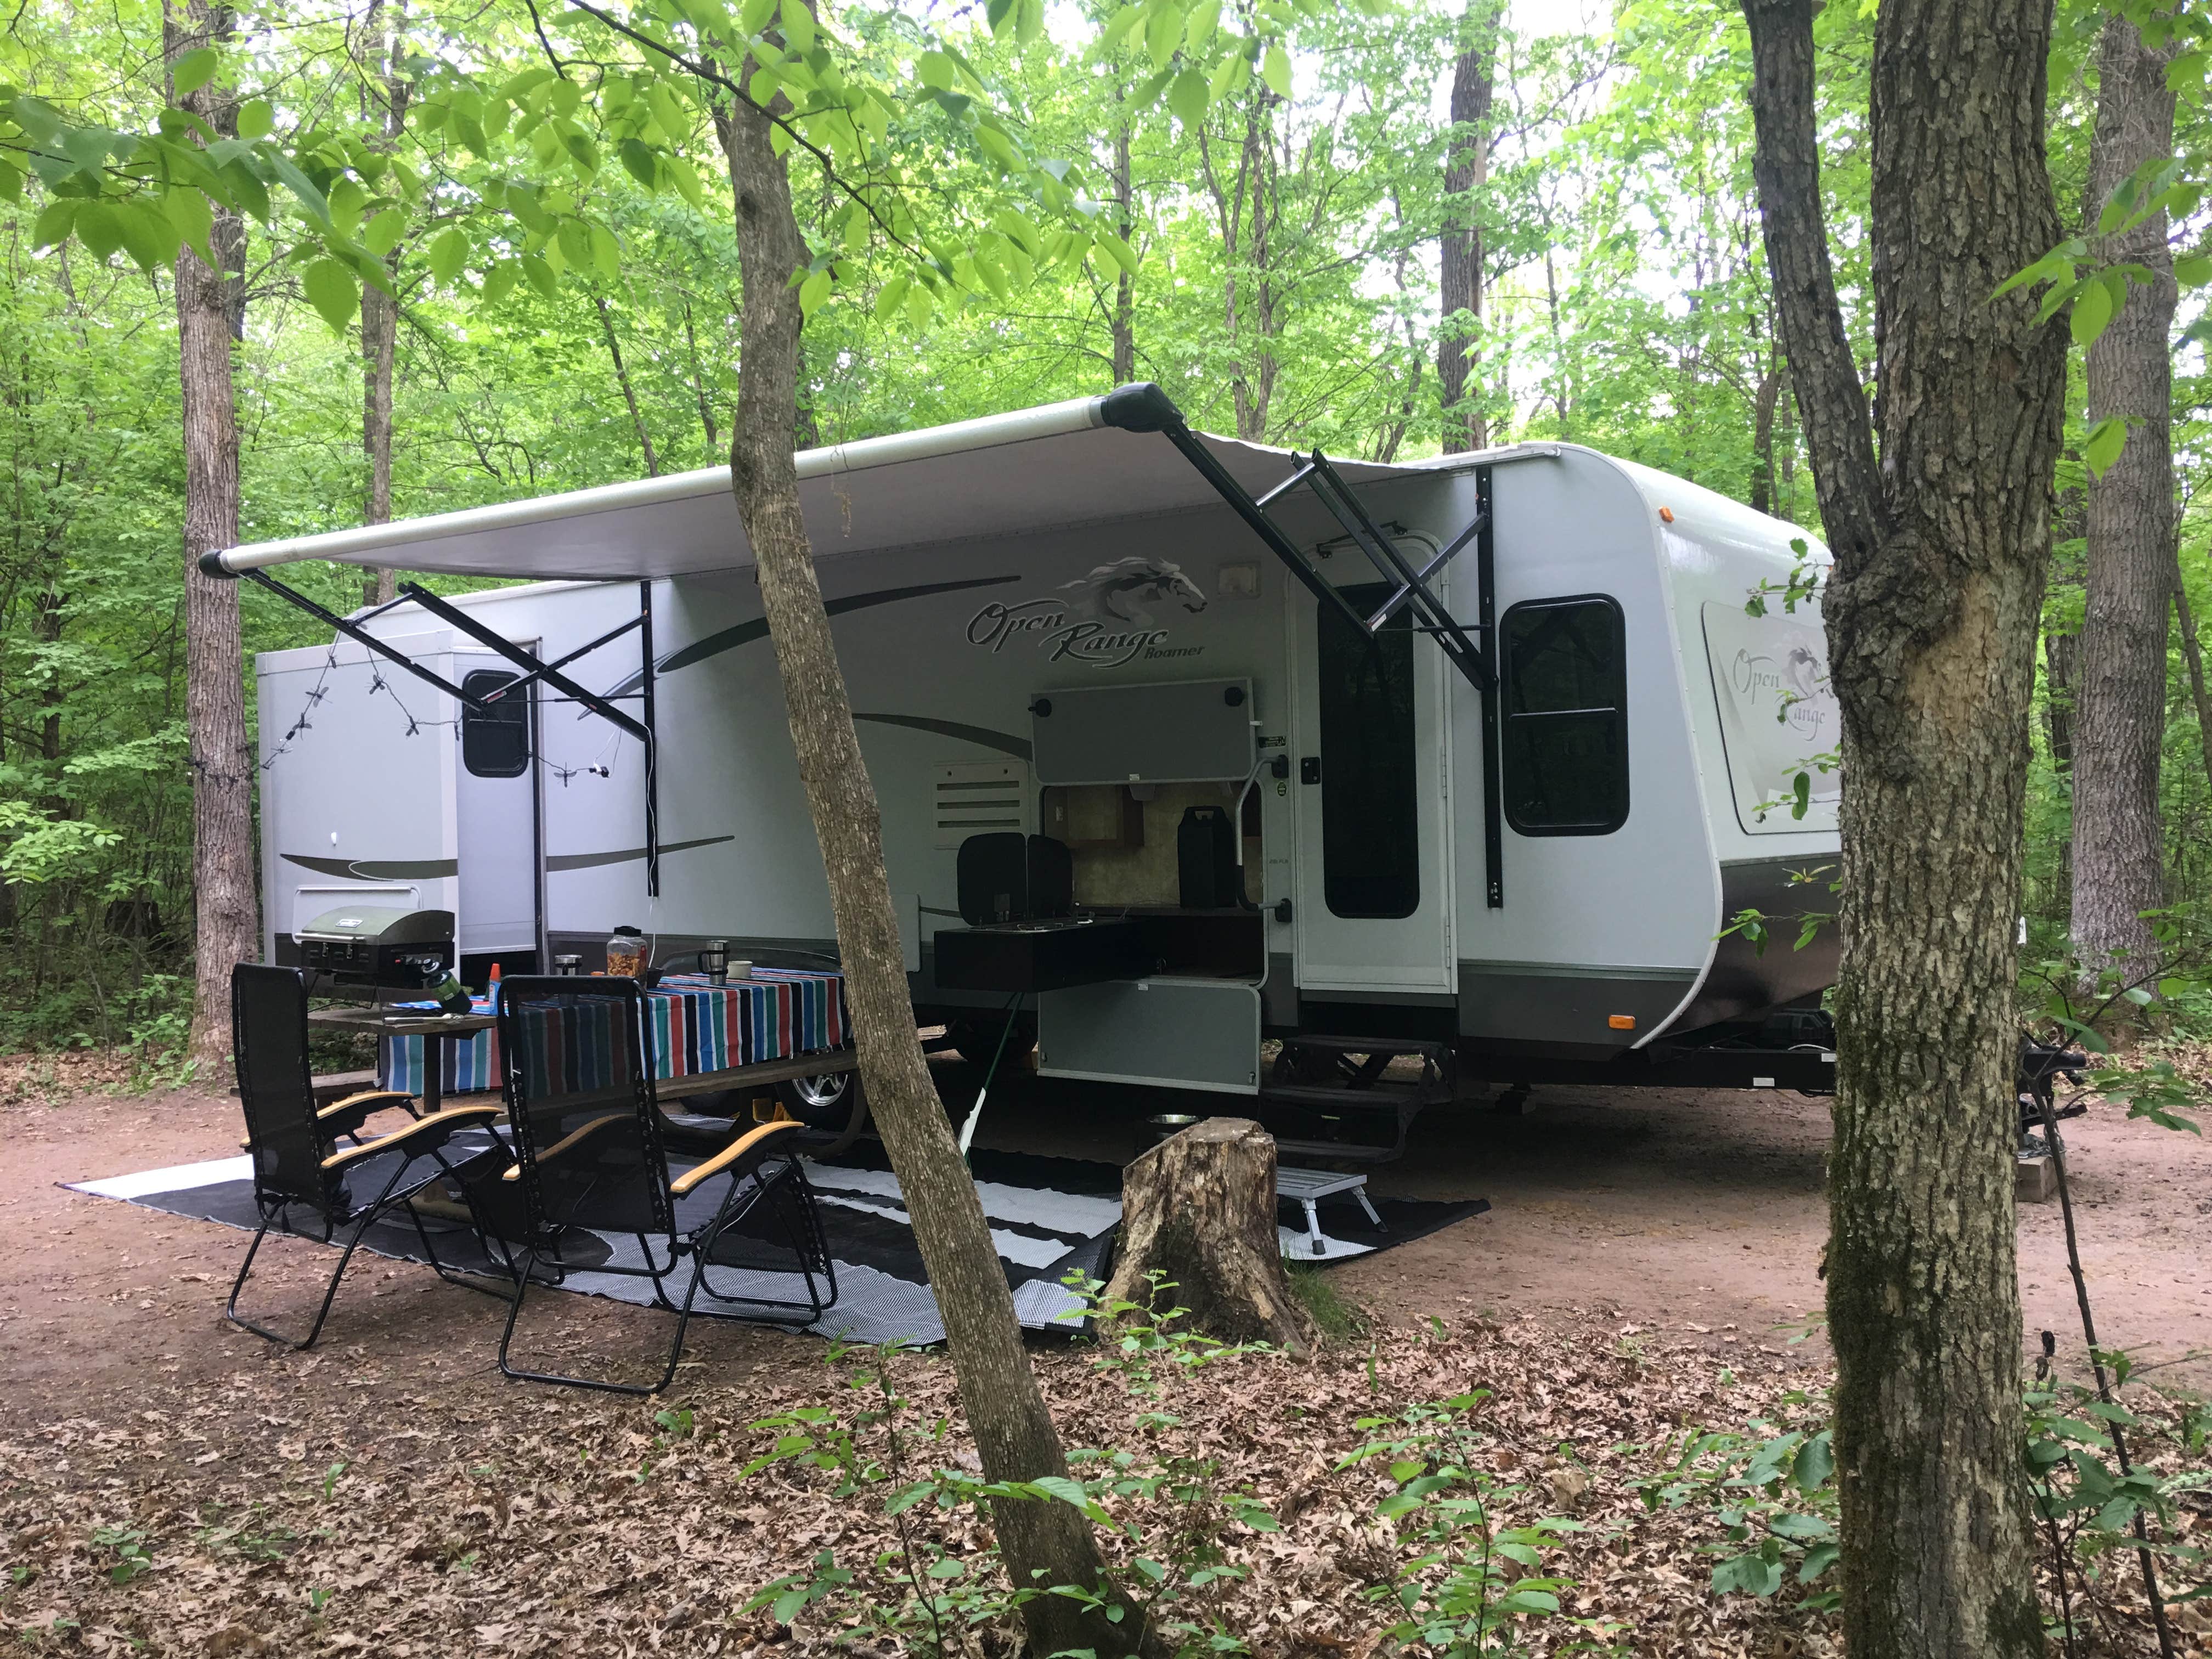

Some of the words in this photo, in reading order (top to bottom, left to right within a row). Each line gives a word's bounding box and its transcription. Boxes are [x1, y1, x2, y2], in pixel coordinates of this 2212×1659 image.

[967, 599, 1069, 653] Open
[1039, 621, 1169, 669] Range
[1144, 645, 1205, 659] Roamer
[1733, 648, 1780, 705] Open
